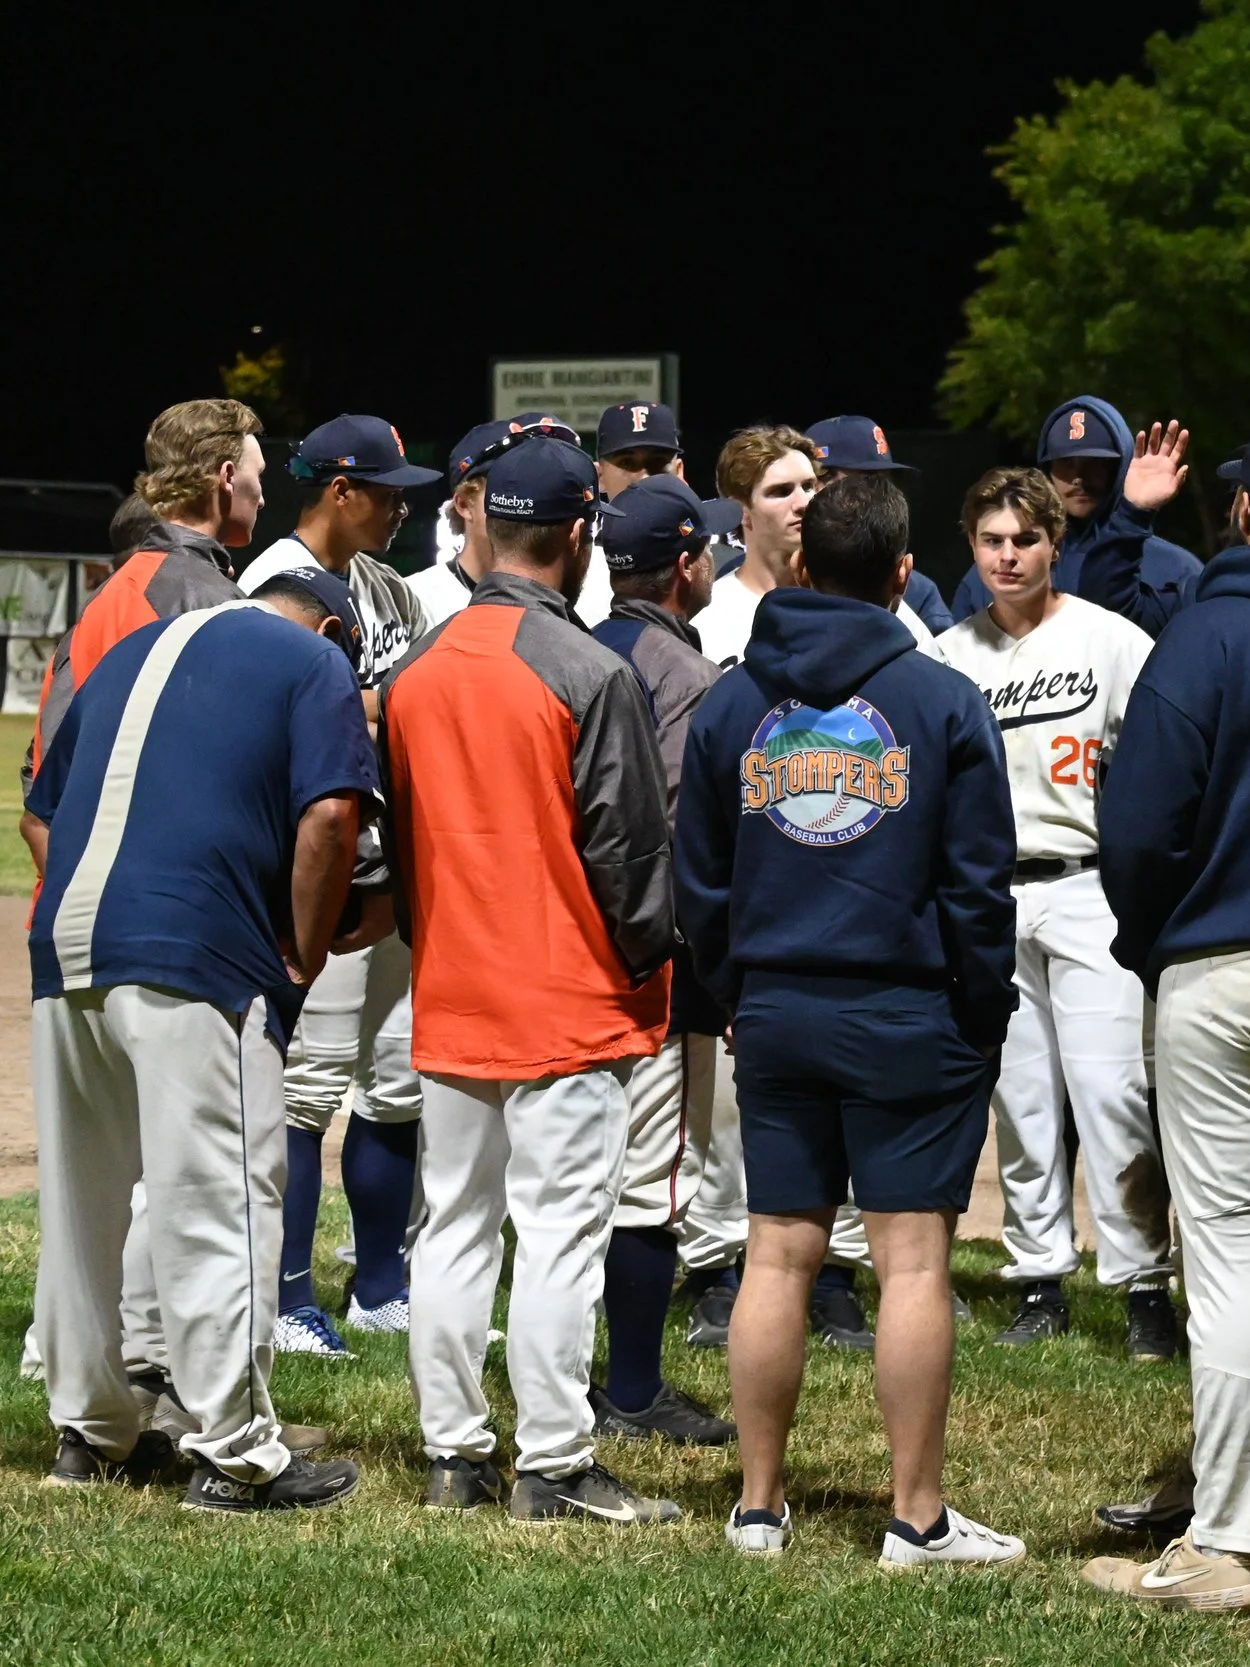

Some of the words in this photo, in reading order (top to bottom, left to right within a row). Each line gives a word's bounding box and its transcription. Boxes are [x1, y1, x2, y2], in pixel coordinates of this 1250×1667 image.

[630, 406, 649, 432] F
[1069, 411, 1085, 440] S
[490, 493, 534, 509] Sotheby's
[979, 668, 1098, 717] ompers
[774, 697, 873, 720] SOMA
[1050, 735, 1102, 788] 26
[740, 745, 911, 815] STOMPERS
[783, 822, 835, 844] BASEBALL
[837, 822, 867, 841] CLUB
[201, 1476, 255, 1501] HOKA
